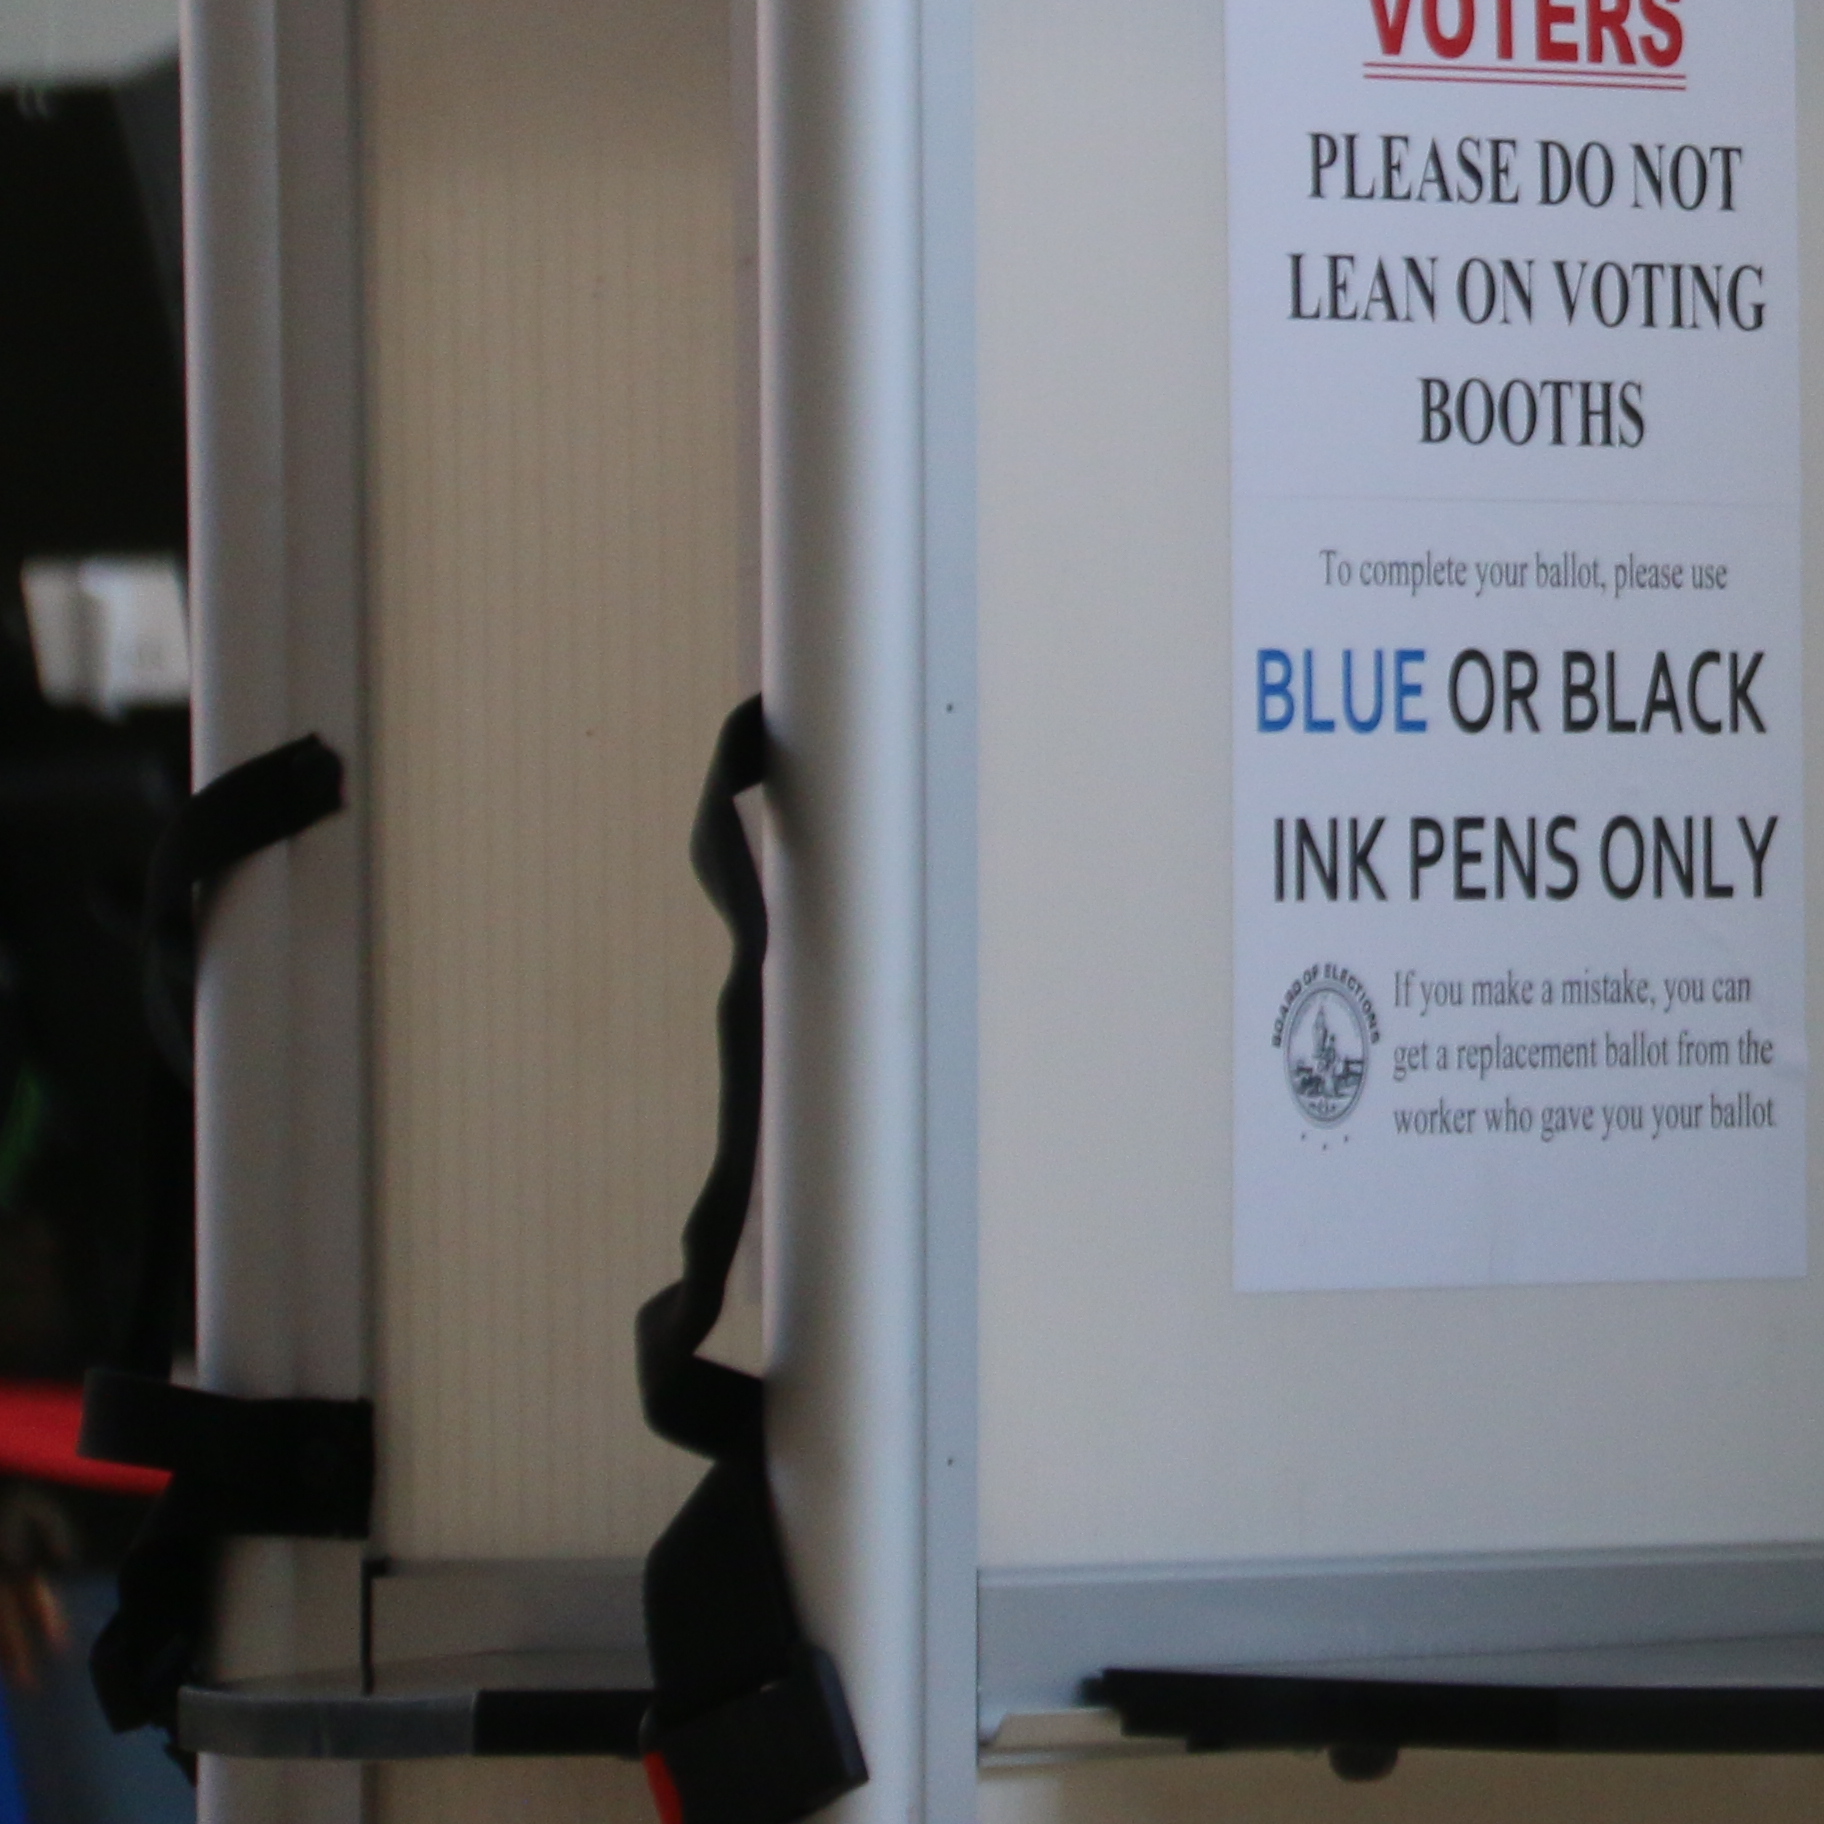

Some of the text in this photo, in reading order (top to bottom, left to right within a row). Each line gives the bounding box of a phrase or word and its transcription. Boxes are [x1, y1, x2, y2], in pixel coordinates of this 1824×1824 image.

[1310, 132, 1743, 212] PLEASE DO NOT
[1290, 253, 1765, 332] LEAN ON VOTING
[1421, 377, 1646, 447] BOOTHS
[1320, 548, 1729, 599] To complete your ballot, please use
[1257, 648, 1766, 734] BLUE OR BLACK
[1274, 814, 1778, 902] INK PENS ONLY
[1271, 962, 1381, 1049] BOARD OF ELECTIONS
[1394, 967, 1753, 1018] If you make a mistake, you can
[1393, 1027, 1775, 1083] get a replacement ballot from the
[1393, 1090, 1776, 1144] worker who gave you your ballot
